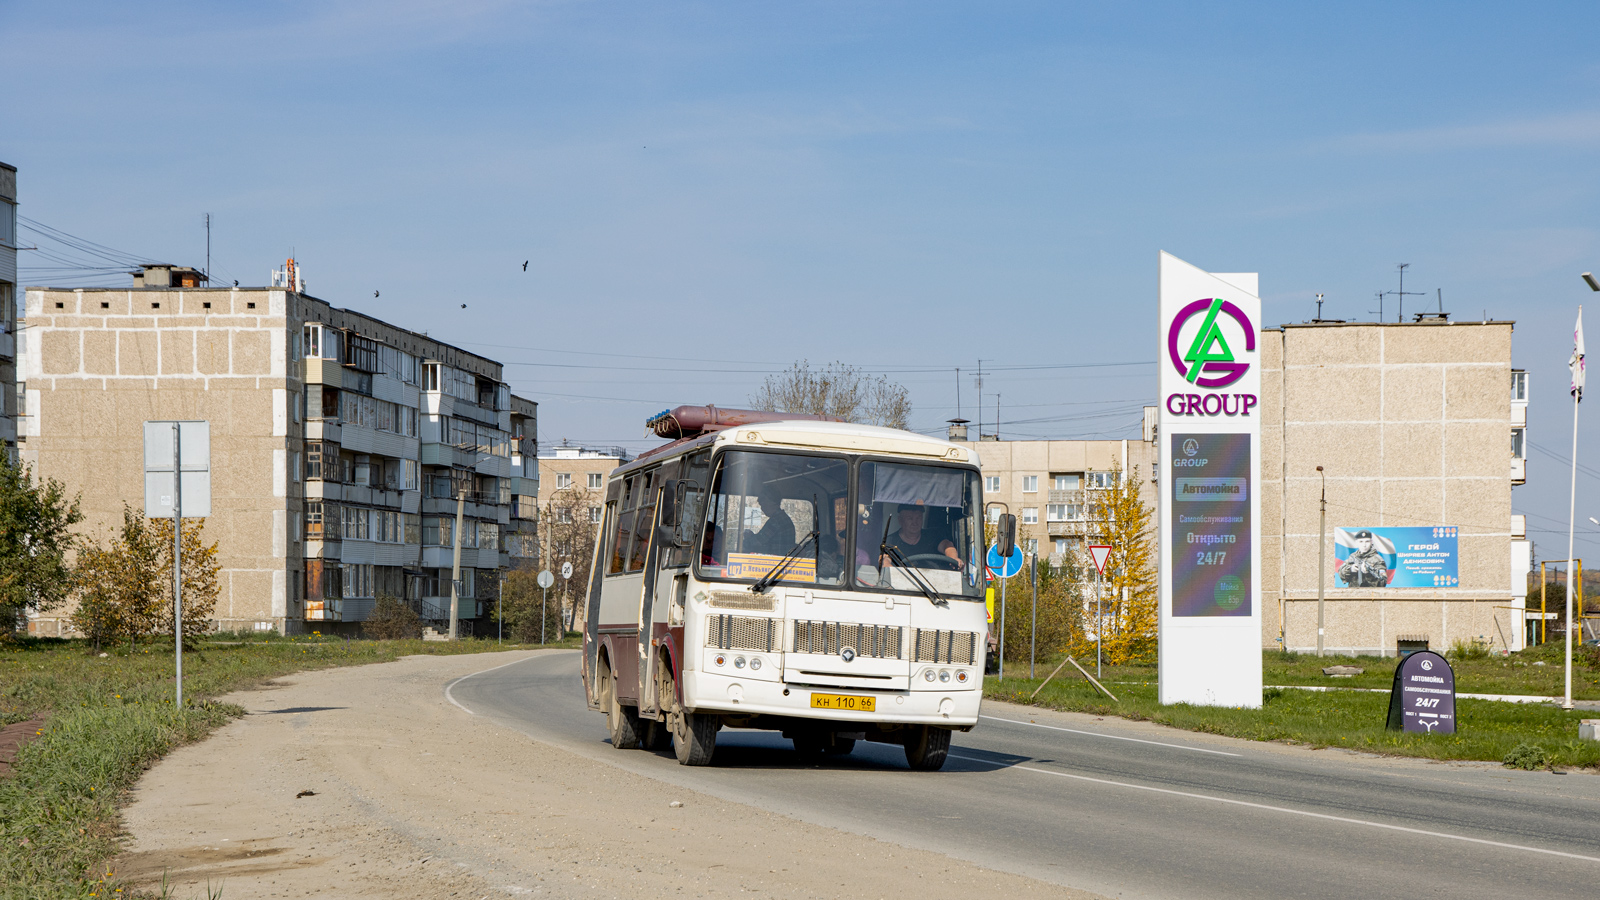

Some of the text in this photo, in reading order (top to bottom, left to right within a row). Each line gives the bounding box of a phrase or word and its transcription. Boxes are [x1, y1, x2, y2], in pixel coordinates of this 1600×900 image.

[1166, 393, 1257, 416] GROUP
[1173, 458, 1208, 467] GROUP
[1182, 483, 1240, 494] Автомойка
[1186, 532, 1236, 546] Открыто
[1196, 551, 1227, 565] 24/7
[563, 566, 571, 574] 20
[1411, 675, 1444, 683] АВТОМОЙКА
[816, 697, 872, 708] КН 110 66
[1415, 697, 1440, 708] 24/7
